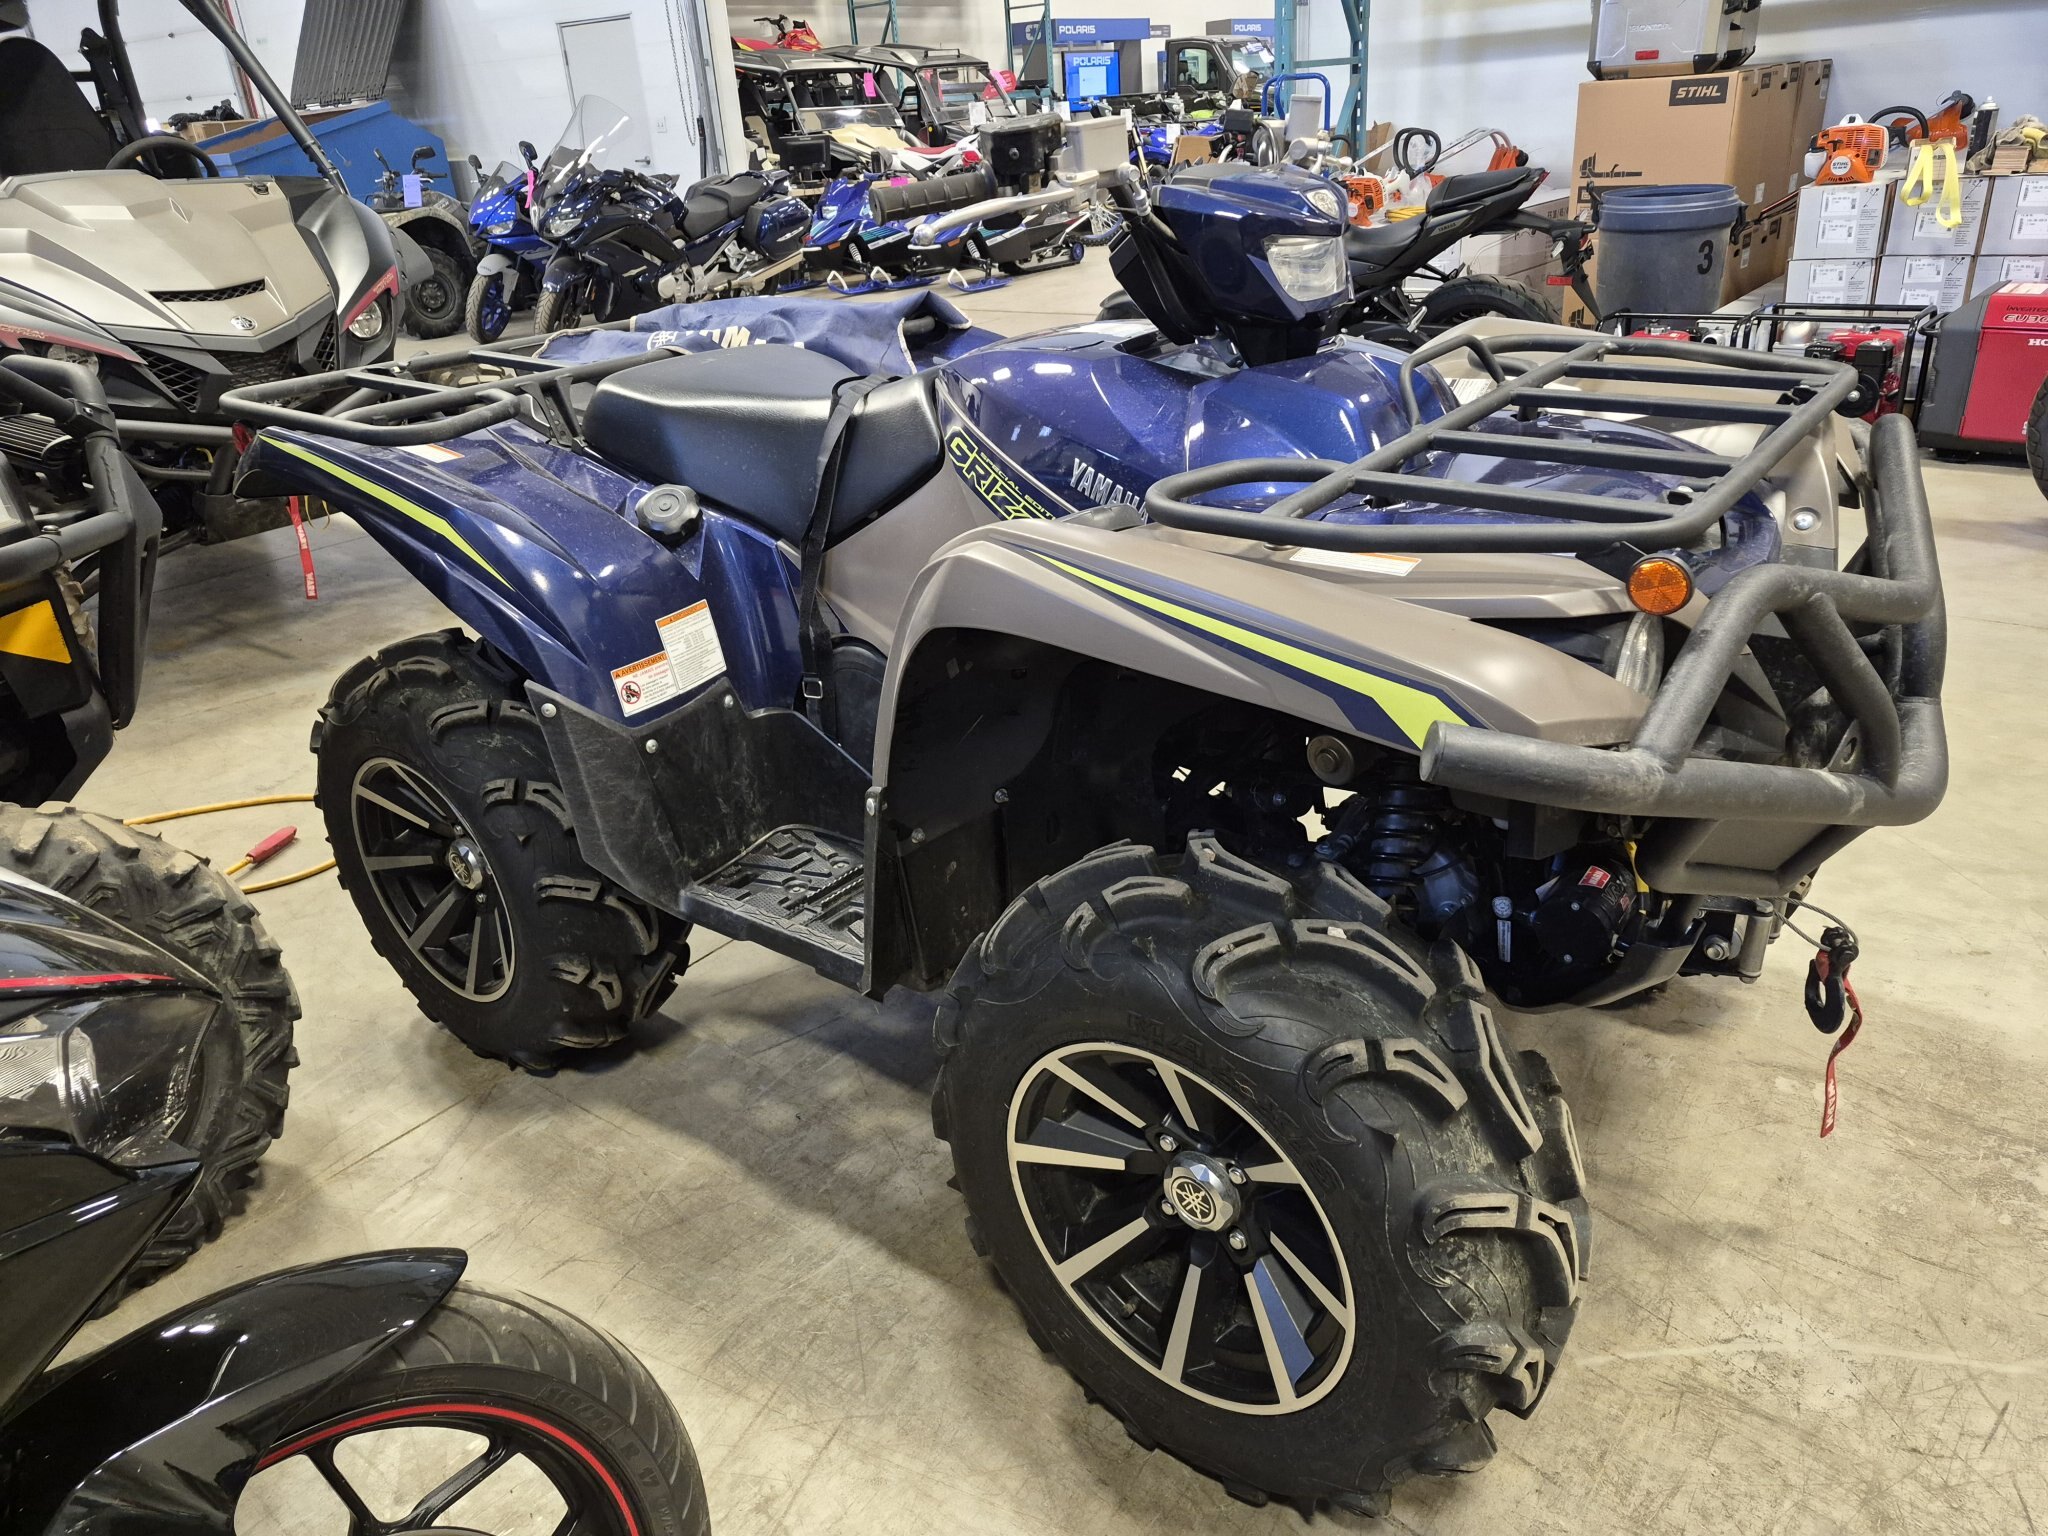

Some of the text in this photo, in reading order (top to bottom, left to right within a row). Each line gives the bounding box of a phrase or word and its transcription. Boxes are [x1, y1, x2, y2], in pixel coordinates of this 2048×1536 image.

[1058, 24, 1096, 35] POLARIS
[1234, 23, 1262, 32] POLARIS
[1073, 55, 1111, 66] POLARIS
[1675, 84, 1721, 99] STIHL
[1696, 239, 1714, 275] 3
[980, 451, 1023, 496] SPECIAL
[620, 652, 667, 677] AVERTISSEMENT
